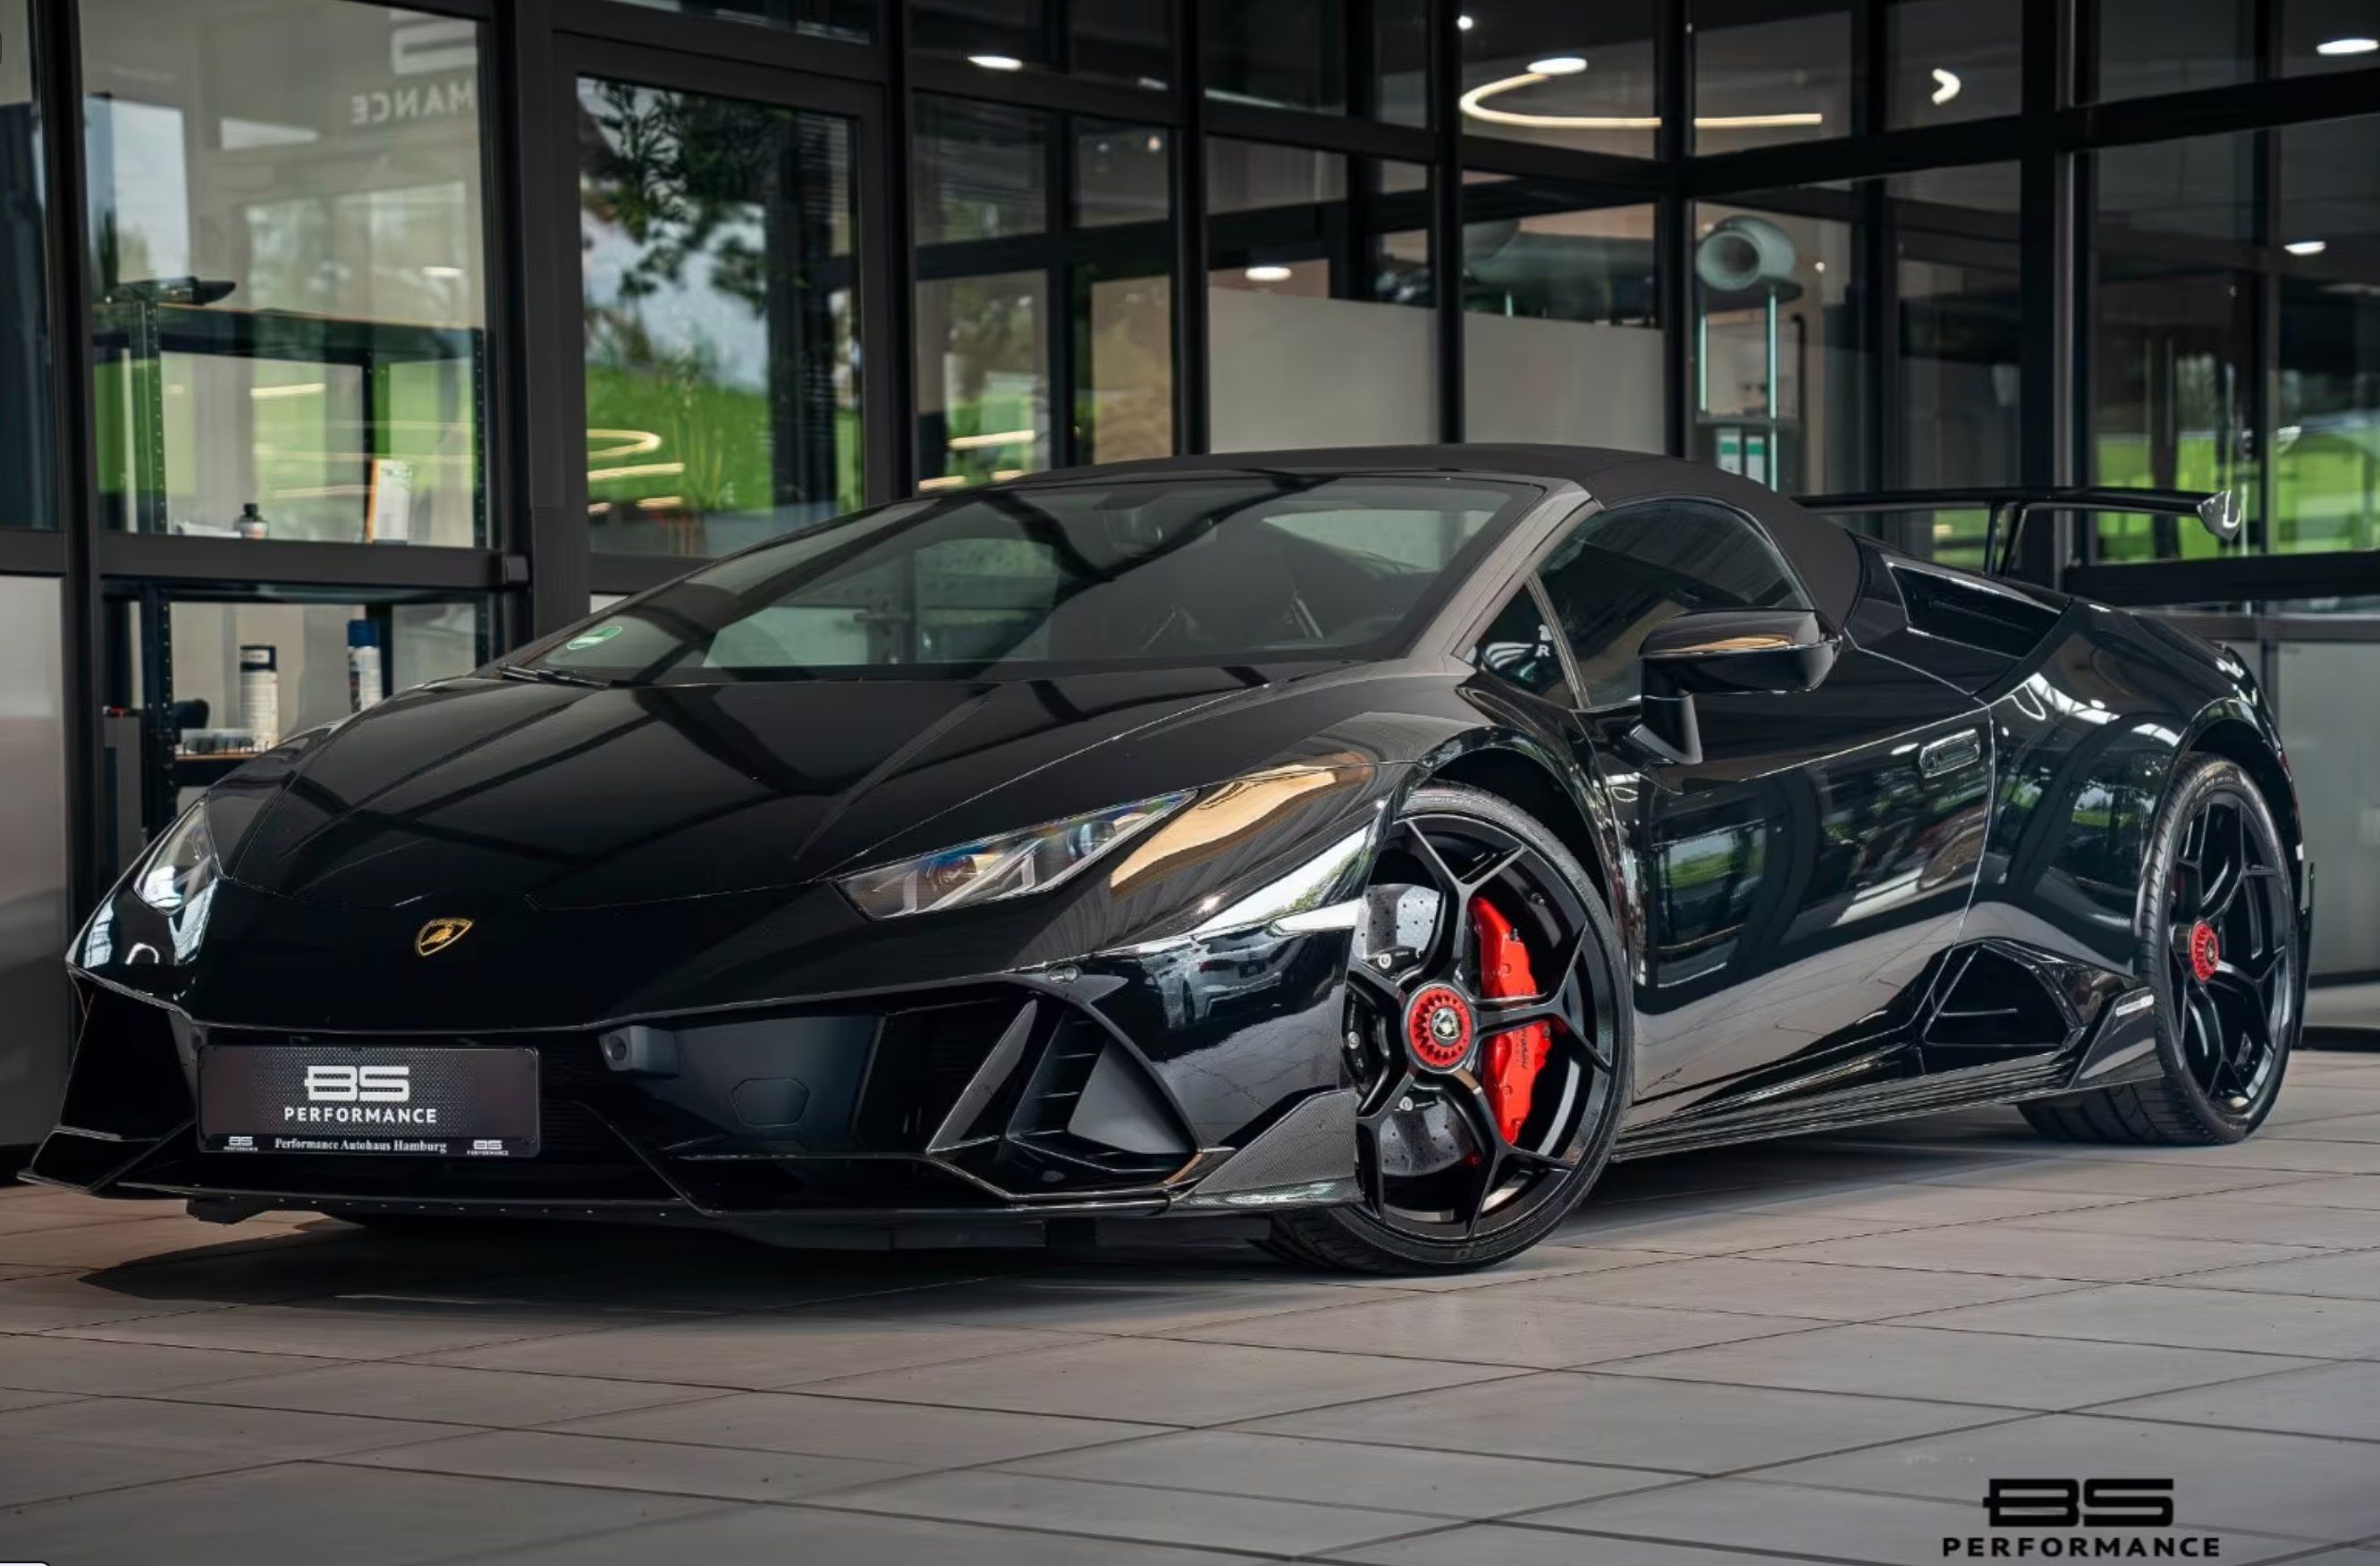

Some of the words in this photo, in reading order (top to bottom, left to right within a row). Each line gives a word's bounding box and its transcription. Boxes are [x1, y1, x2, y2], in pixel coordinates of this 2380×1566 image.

[304, 1065, 409, 1102] BS
[284, 1107, 437, 1124] PERFORMANCE
[274, 1138, 339, 1150] Performance
[340, 1140, 392, 1151] Autohaus
[393, 1140, 447, 1154] Hamburg
[473, 1140, 502, 1149] BS
